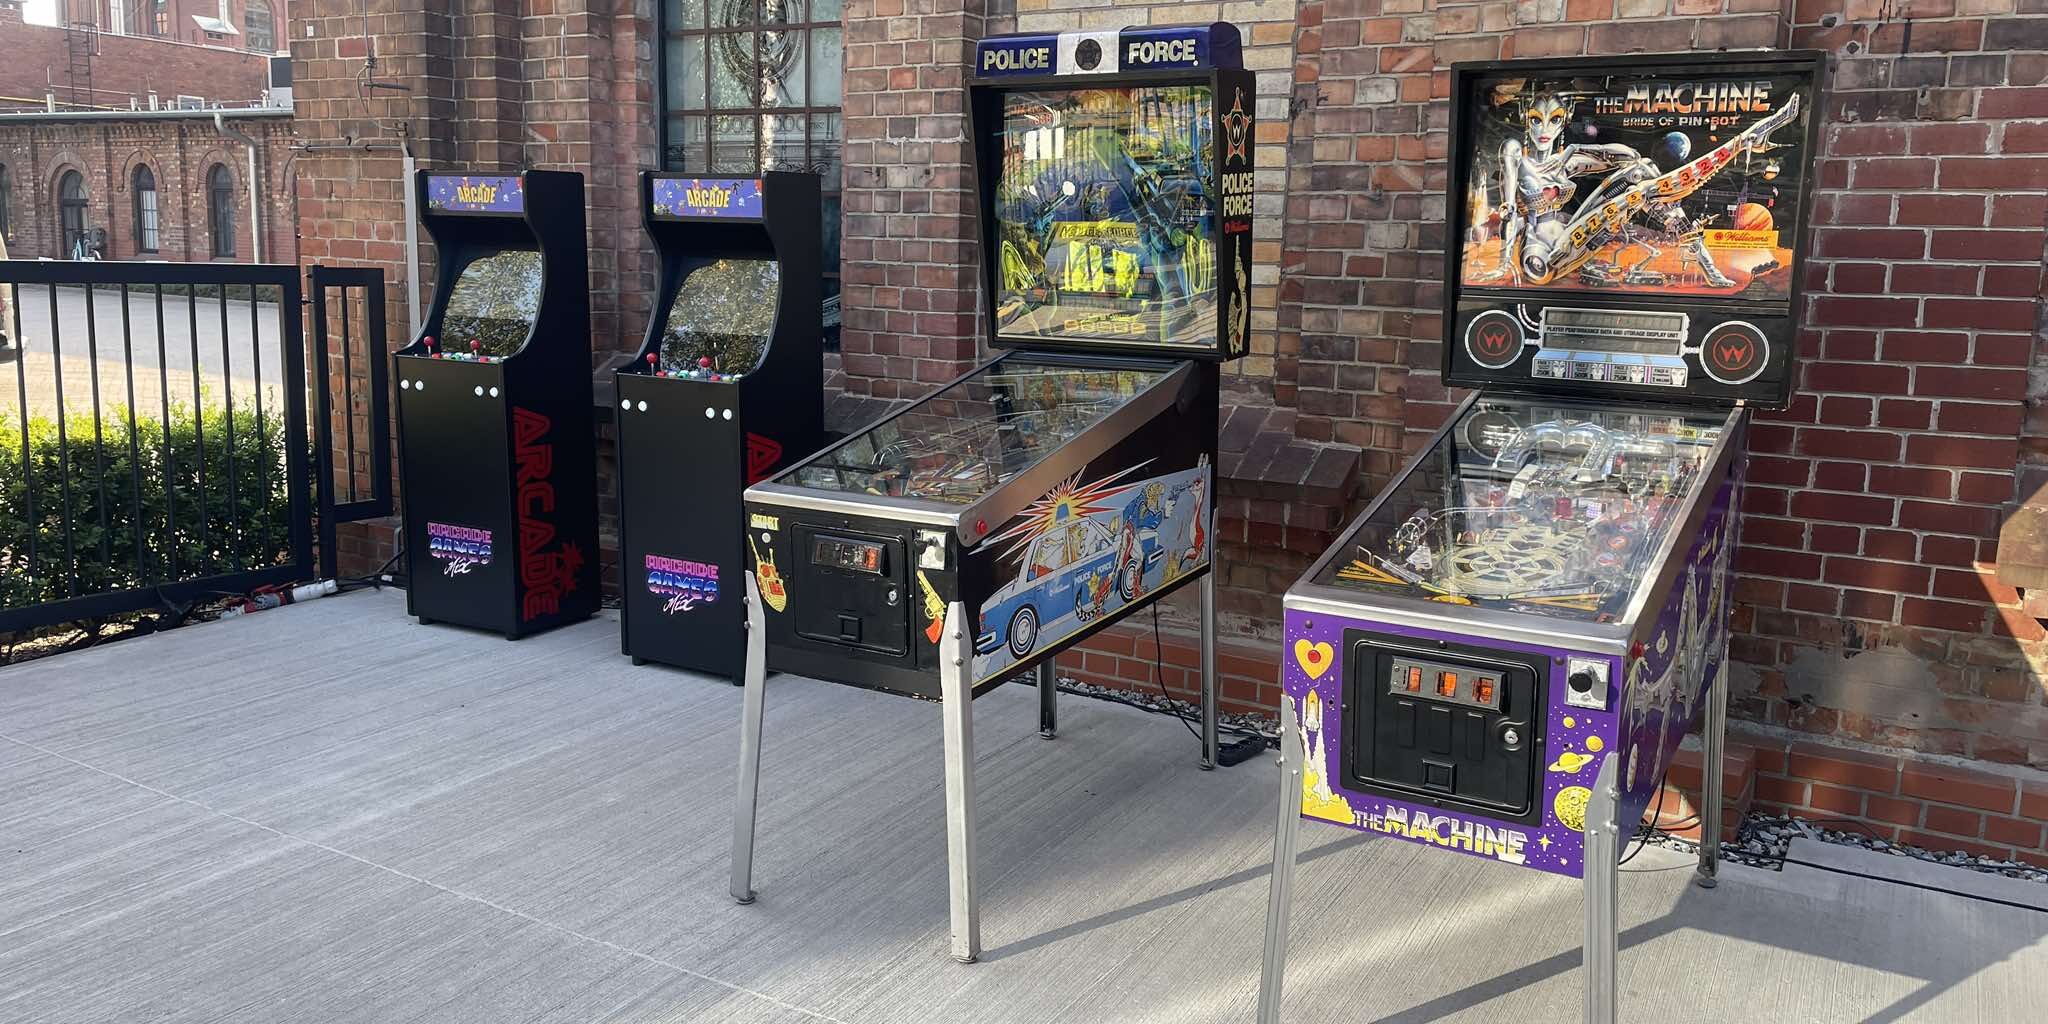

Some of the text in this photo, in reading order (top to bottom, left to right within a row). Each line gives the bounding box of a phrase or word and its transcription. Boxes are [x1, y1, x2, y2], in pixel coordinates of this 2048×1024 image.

[983, 39, 1195, 71] POLICE FORCE
[1595, 80, 1773, 114] THE MACHINE
[1622, 117, 1655, 127] BRIDE
[1658, 117, 1674, 127] OF
[1681, 172, 1690, 181] 3
[1701, 162, 1709, 170] 2
[1222, 172, 1254, 195] POLICE
[1662, 180, 1670, 189] 4
[457, 185, 497, 204] ARCADE
[686, 187, 731, 208] ARCADE
[1223, 194, 1252, 217] FORCE
[1606, 207, 1614, 215] 6
[1590, 218, 1597, 226] 7
[1574, 231, 1582, 240] 8
[1724, 231, 1769, 242] Williams
[1721, 345, 1747, 363] W
[512, 406, 560, 623] ARCADE
[750, 513, 780, 531] START
[427, 521, 493, 544] ARCADE
[430, 537, 493, 565] GAMES
[444, 556, 473, 578] Mix
[645, 554, 720, 580] ARCADE
[1074, 571, 1091, 584] POLICE
[647, 571, 720, 602] GAMES
[662, 593, 695, 616] Mix
[1353, 804, 1528, 866] THE MACHINE
